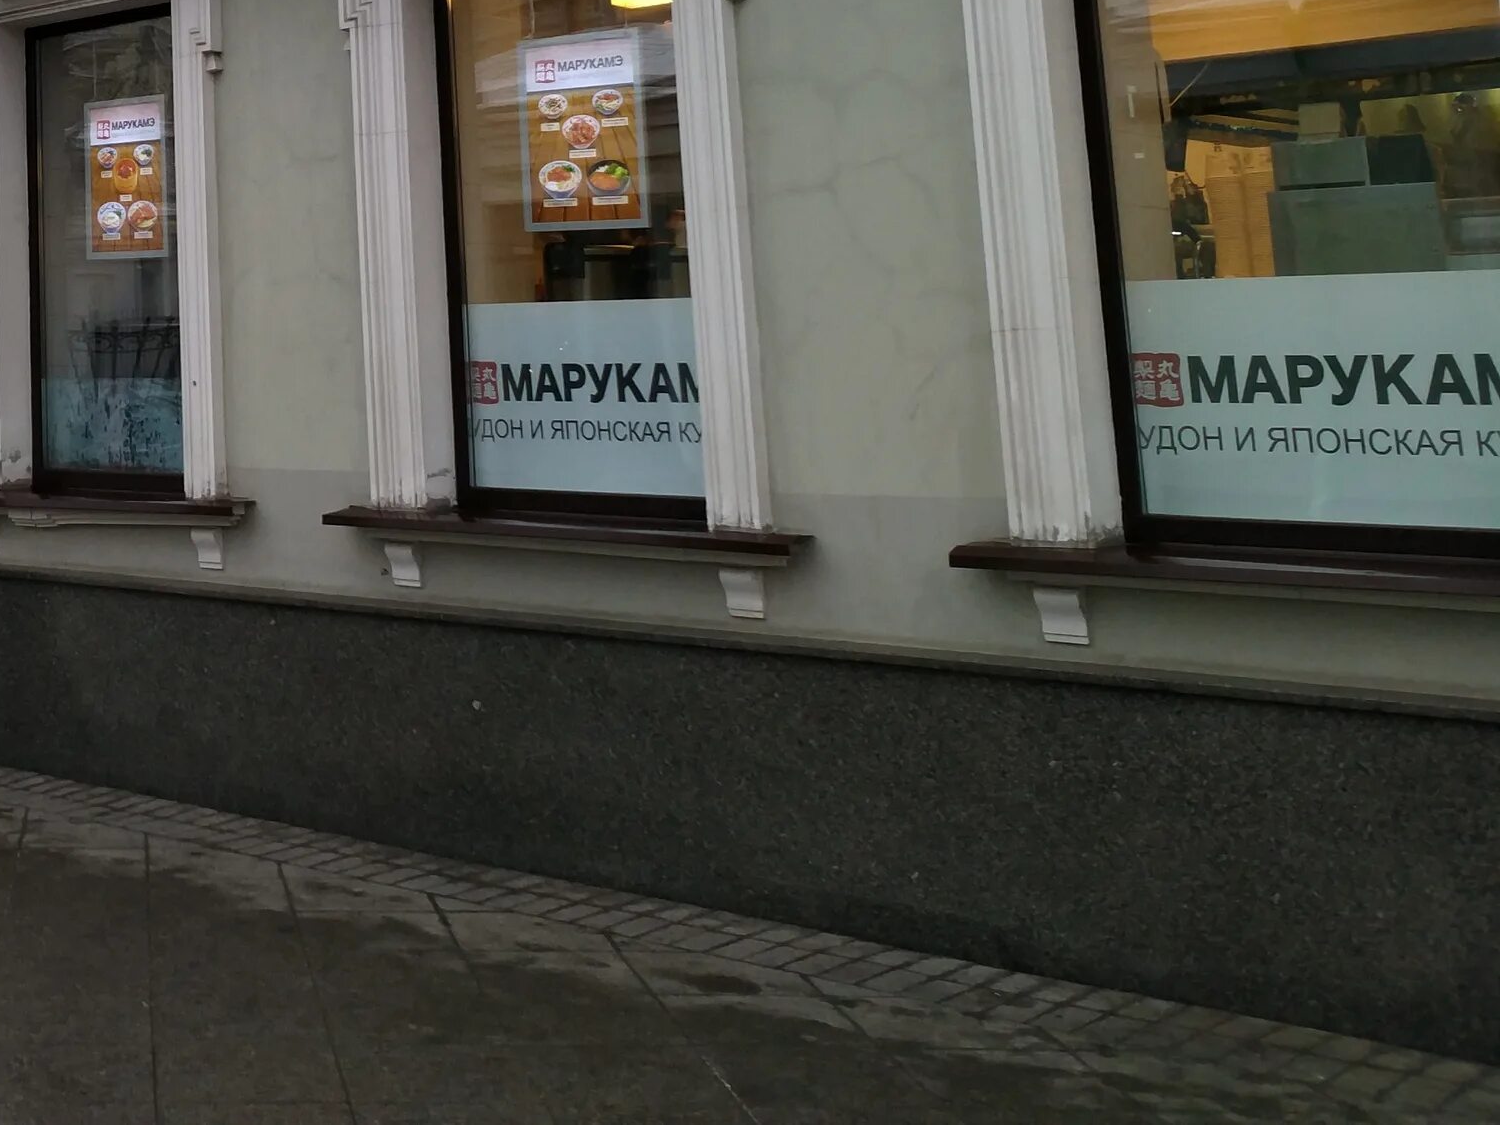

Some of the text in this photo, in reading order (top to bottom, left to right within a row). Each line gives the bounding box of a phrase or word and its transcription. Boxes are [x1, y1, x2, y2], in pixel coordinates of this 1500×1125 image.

[557, 55, 624, 73] МАРУКАМЭ
[111, 117, 156, 131] МАРУКАМЭ
[530, 420, 544, 440] И
[550, 421, 672, 443] ЯПОНСКАЯ
[1138, 425, 1224, 455] УДОН
[1235, 427, 1257, 452] И
[1267, 427, 1465, 456] ЯПОНСКАЯ
